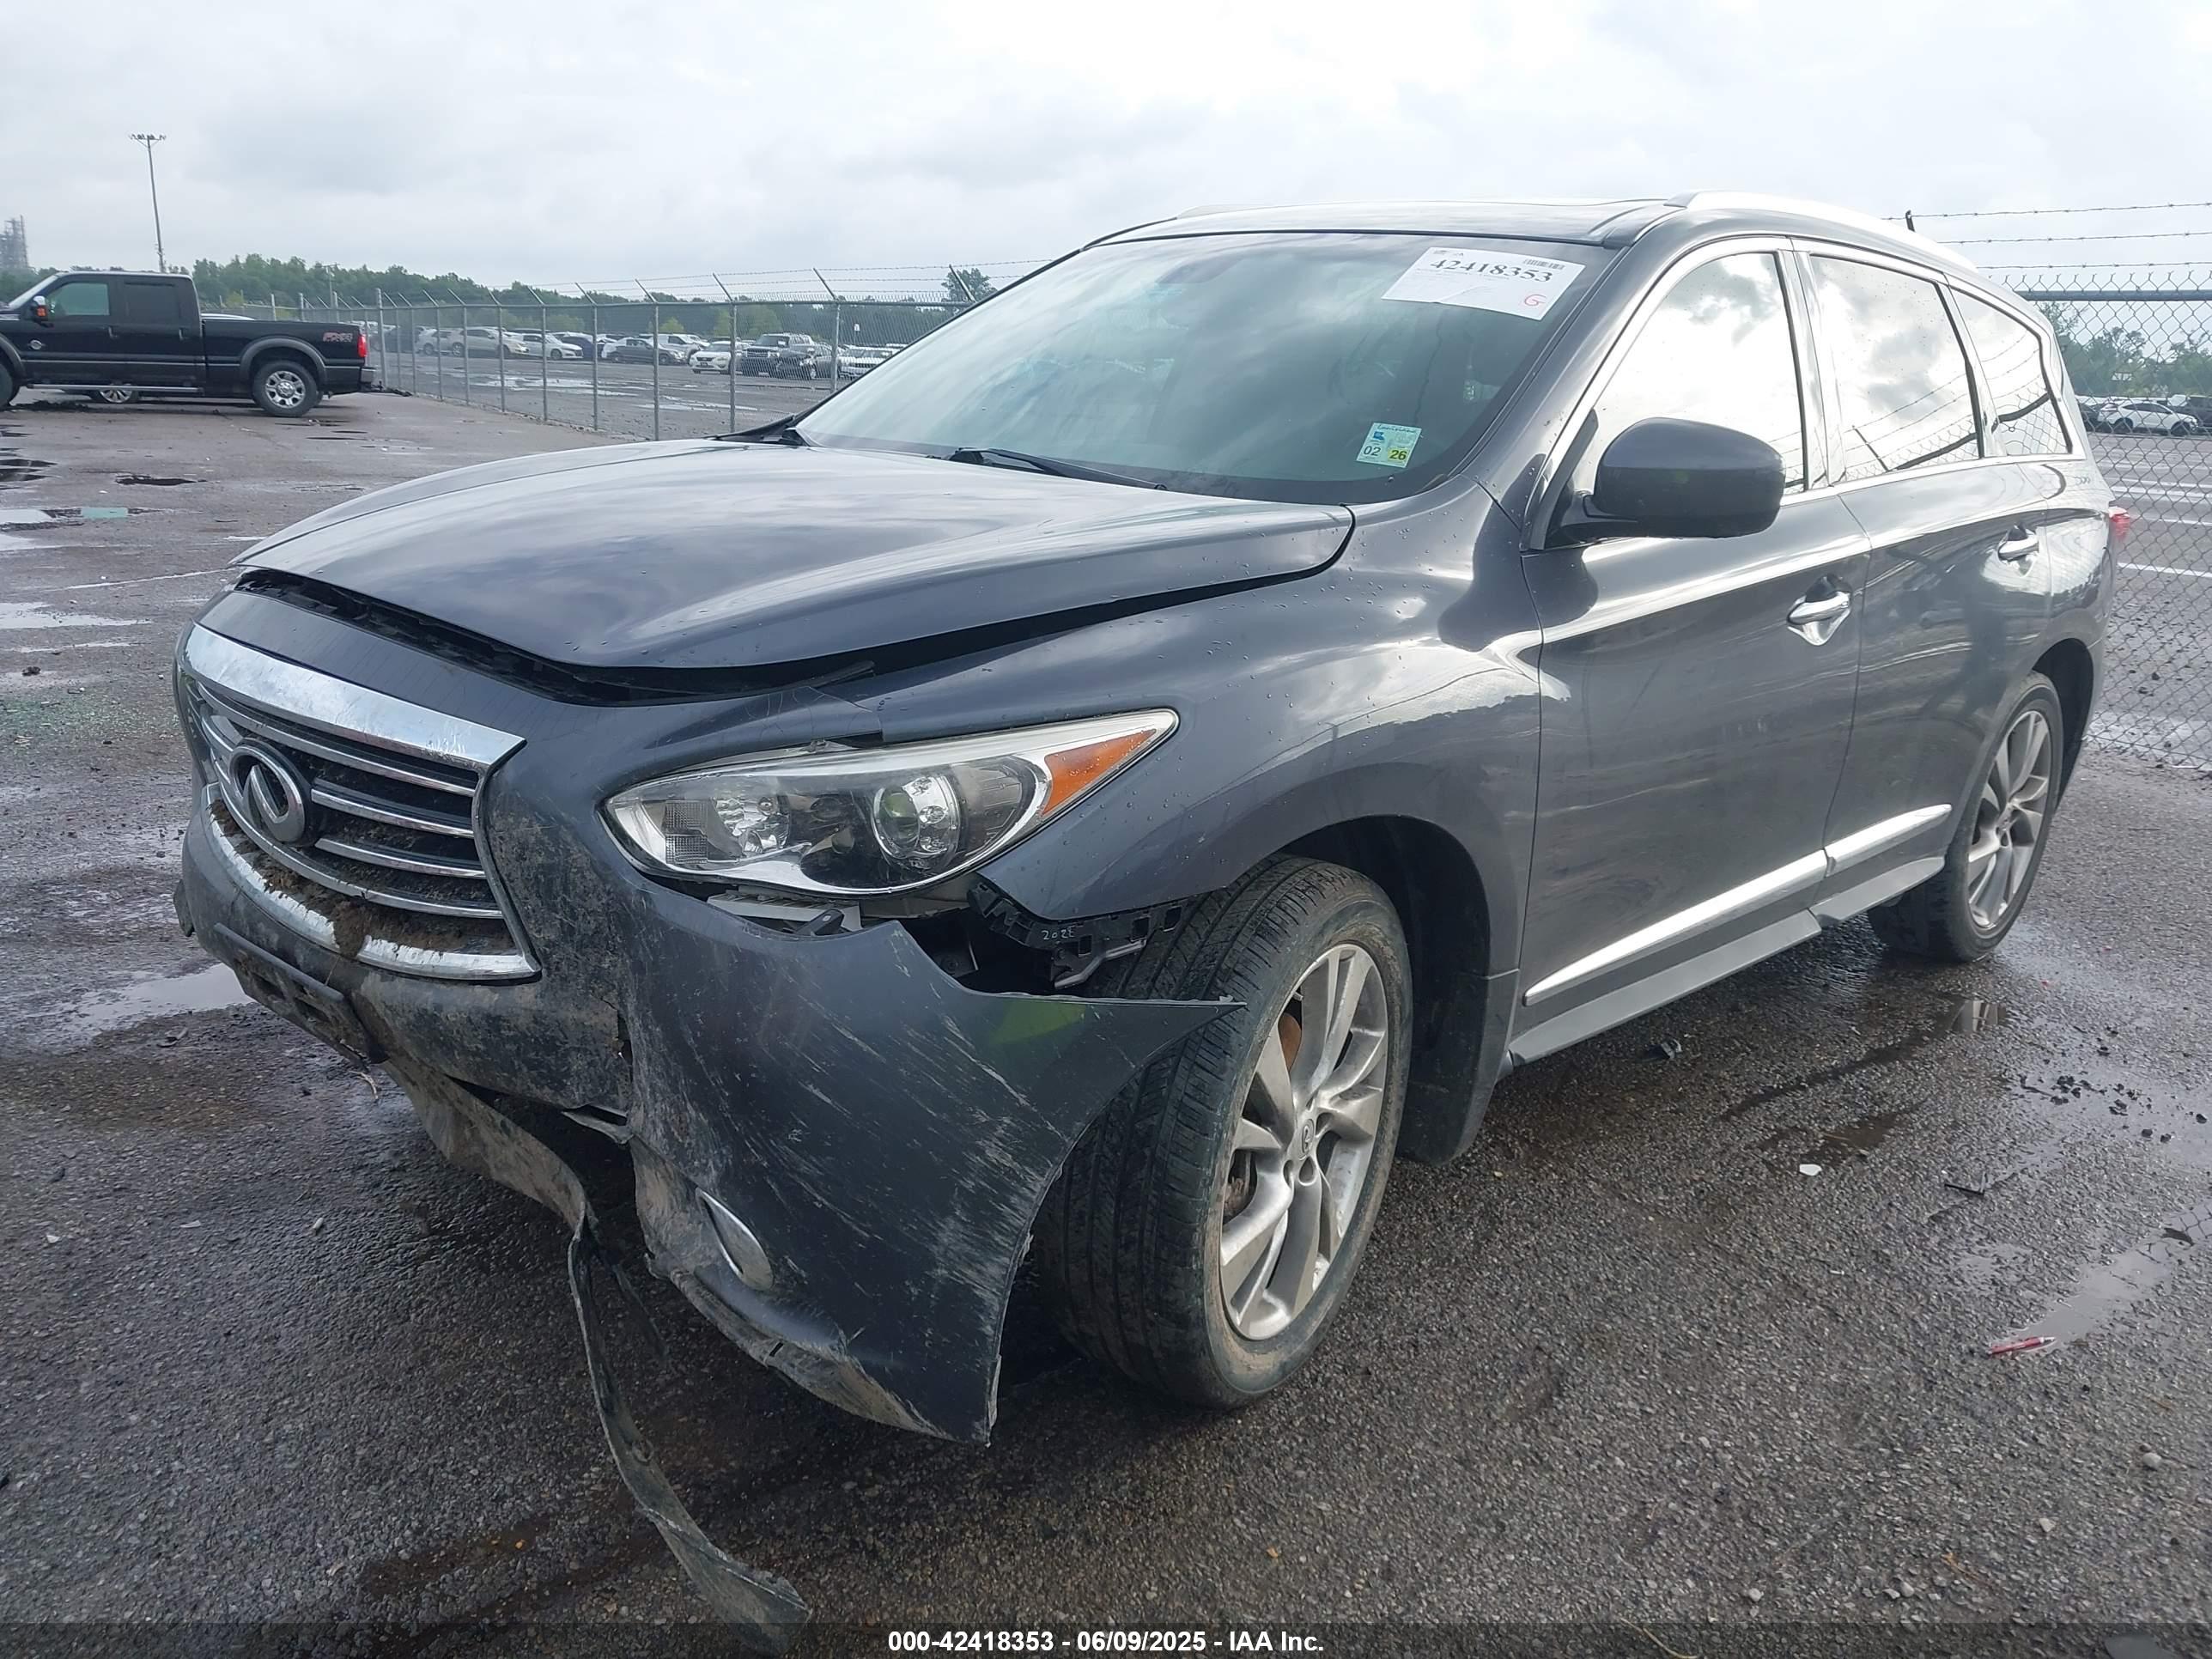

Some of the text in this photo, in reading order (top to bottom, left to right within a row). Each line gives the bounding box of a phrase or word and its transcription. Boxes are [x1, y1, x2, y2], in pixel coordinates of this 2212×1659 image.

[1429, 259, 1553, 283] 42418353
[1364, 446, 1382, 457] 02
[1389, 449, 1408, 460] 26
